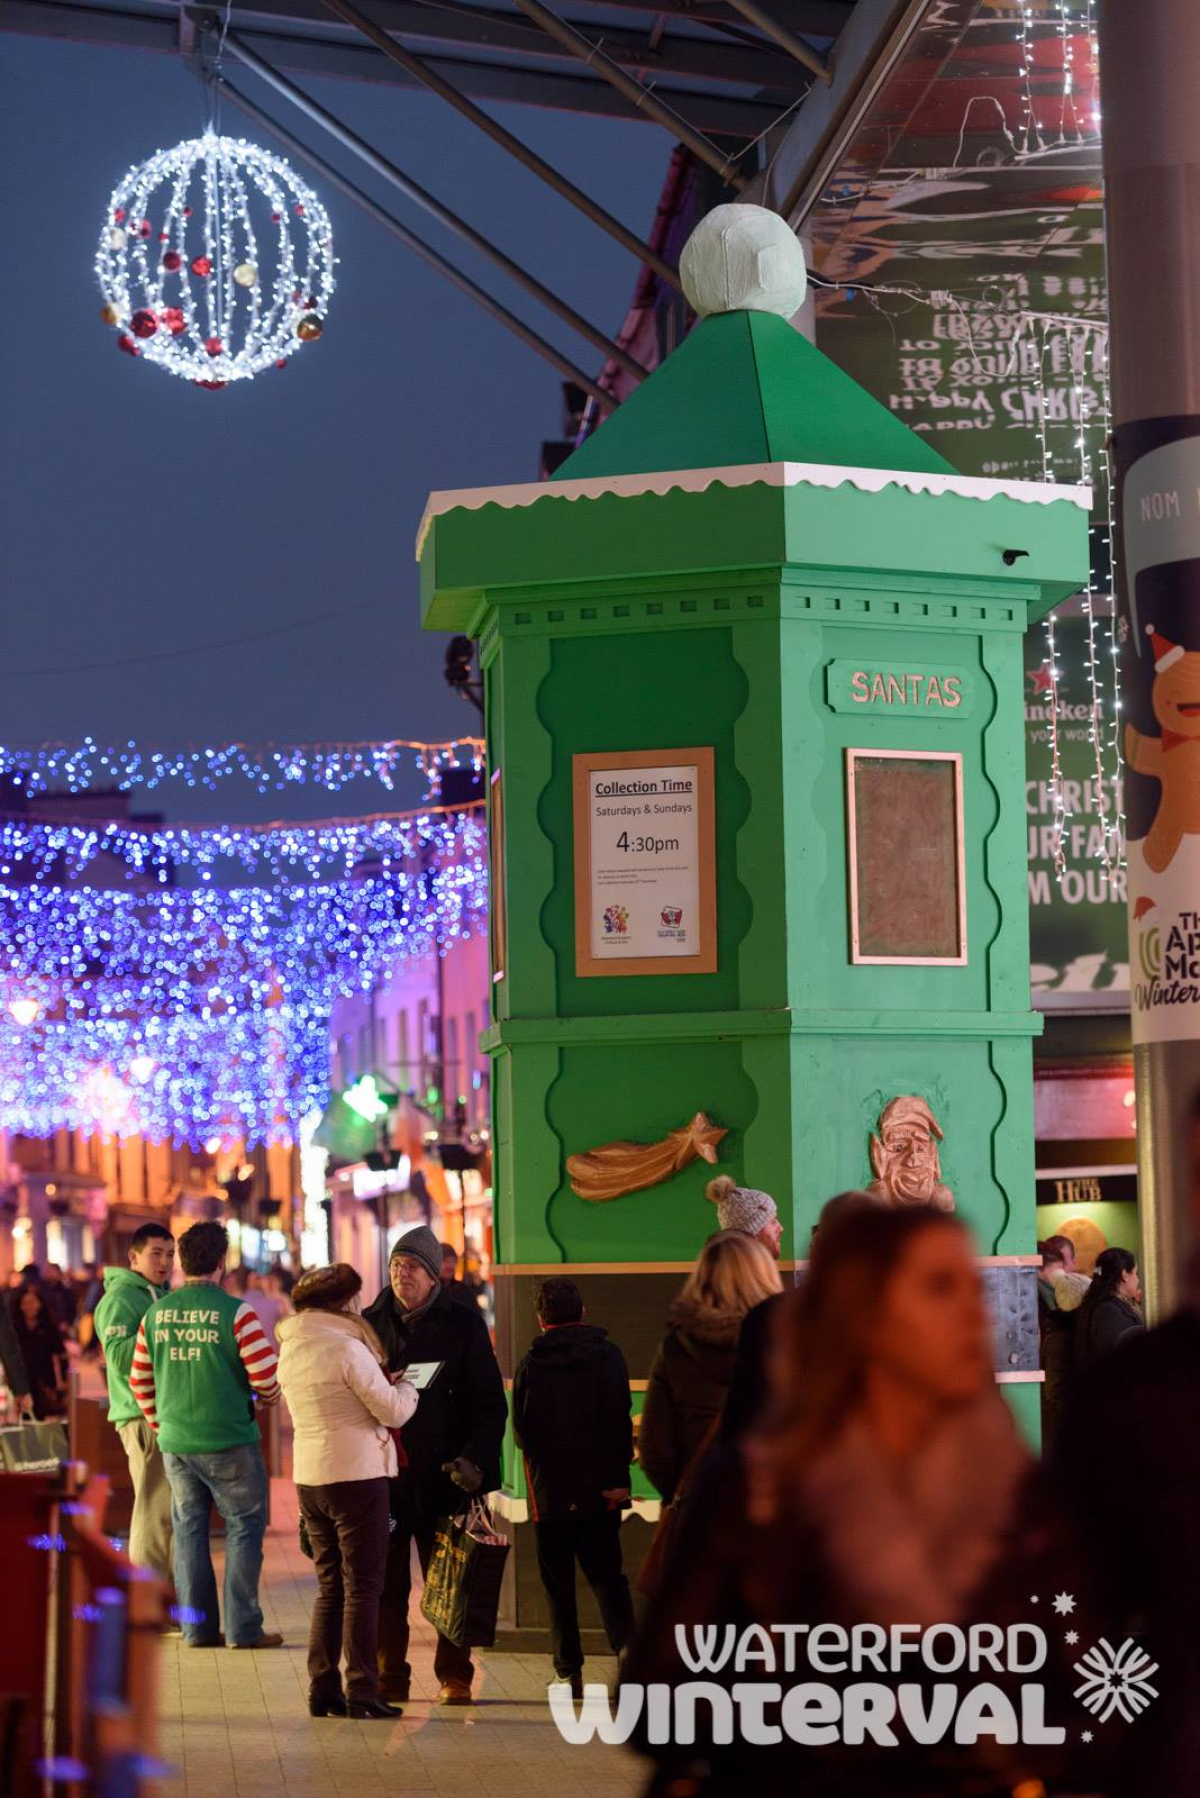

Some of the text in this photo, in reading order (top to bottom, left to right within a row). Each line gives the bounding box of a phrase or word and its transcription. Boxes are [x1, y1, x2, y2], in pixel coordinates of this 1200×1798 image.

[1140, 490, 1181, 522] NOM
[595, 779, 693, 795] Collection Time
[596, 803, 693, 817] Saturdays & Sundays
[616, 831, 679, 854] 4:30pm
[1061, 869, 1128, 904] OUR
[1054, 1180, 1102, 1204] HUB
[155, 1309, 220, 1325] BELIEVE
[155, 1329, 219, 1344] IN YOUR
[169, 1346, 201, 1362] ELF!
